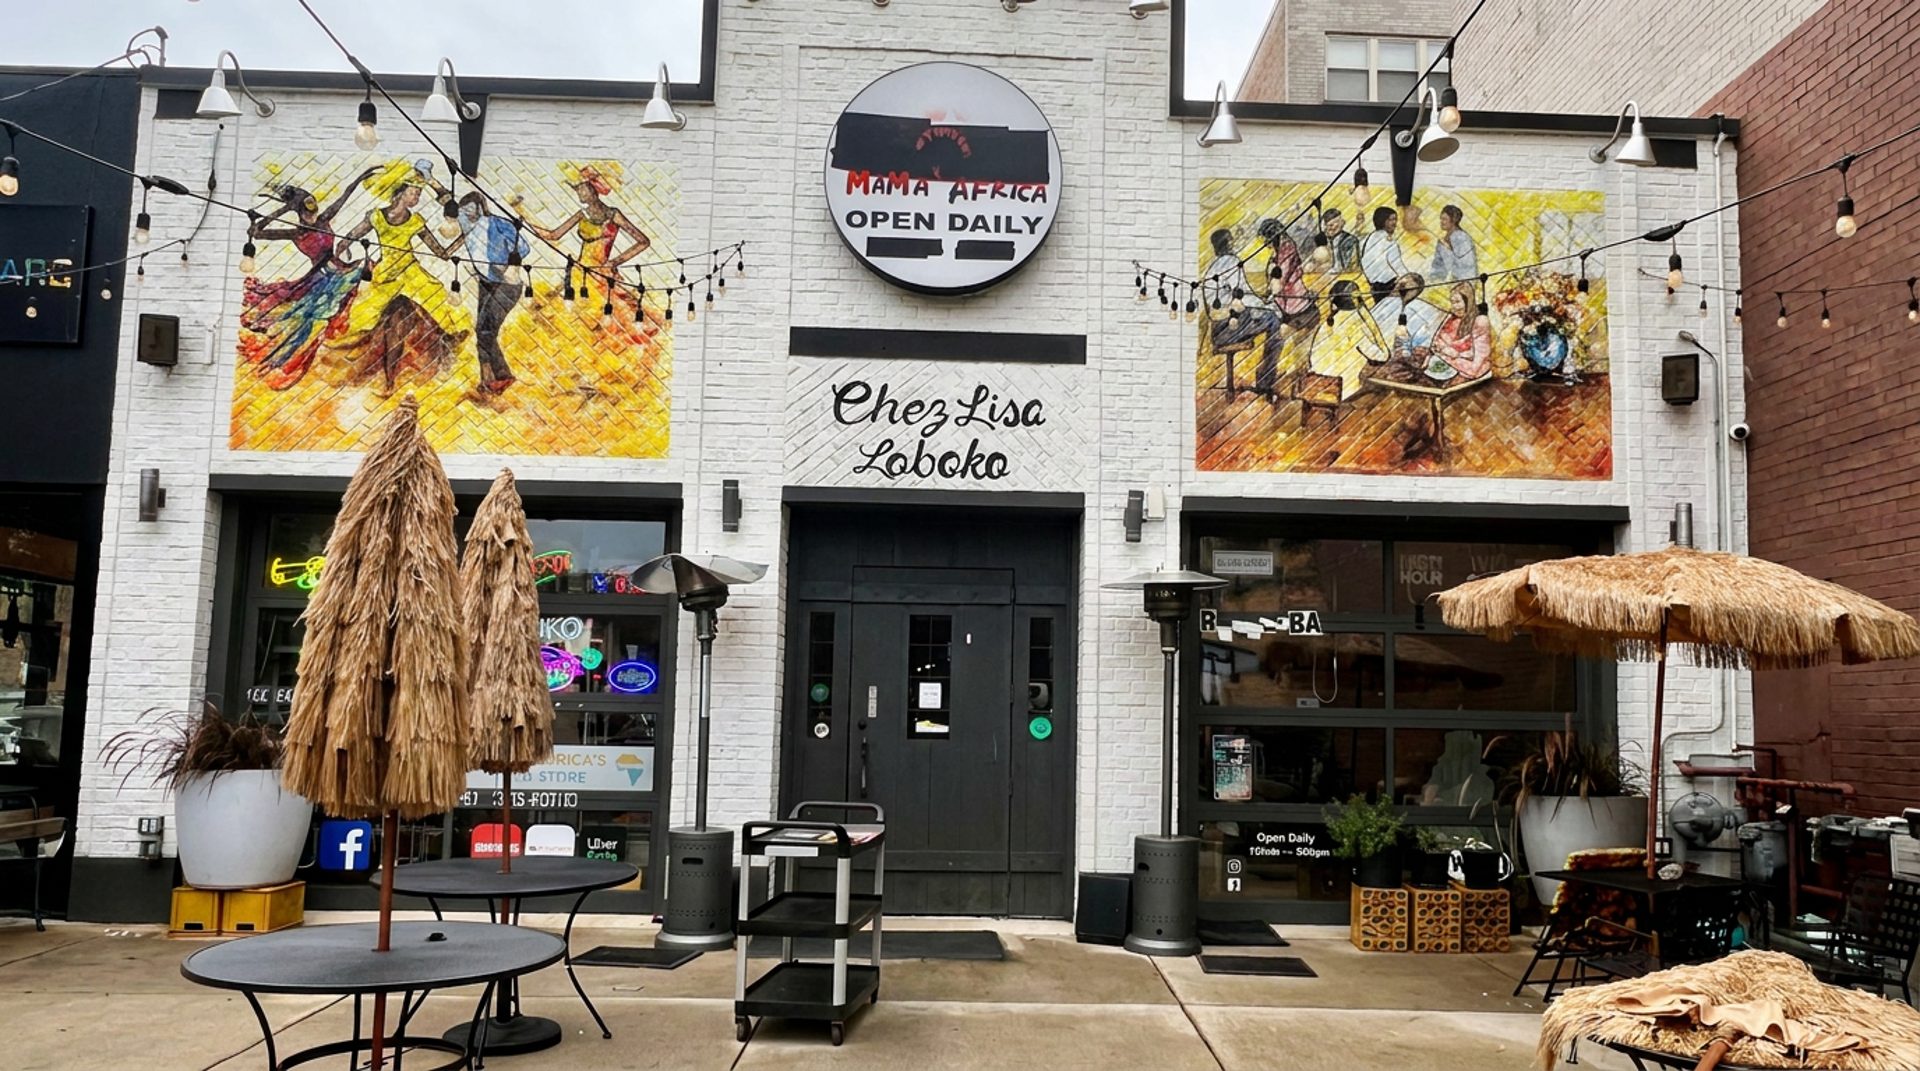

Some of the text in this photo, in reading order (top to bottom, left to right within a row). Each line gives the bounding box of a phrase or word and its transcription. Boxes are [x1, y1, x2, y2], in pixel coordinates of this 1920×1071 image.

[845, 210, 1043, 235] OPEN DAILY
[832, 380, 1046, 438] Chez Lisa
[852, 437, 1010, 480] Loboko
[1256, 832, 1316, 845] Open Daily
